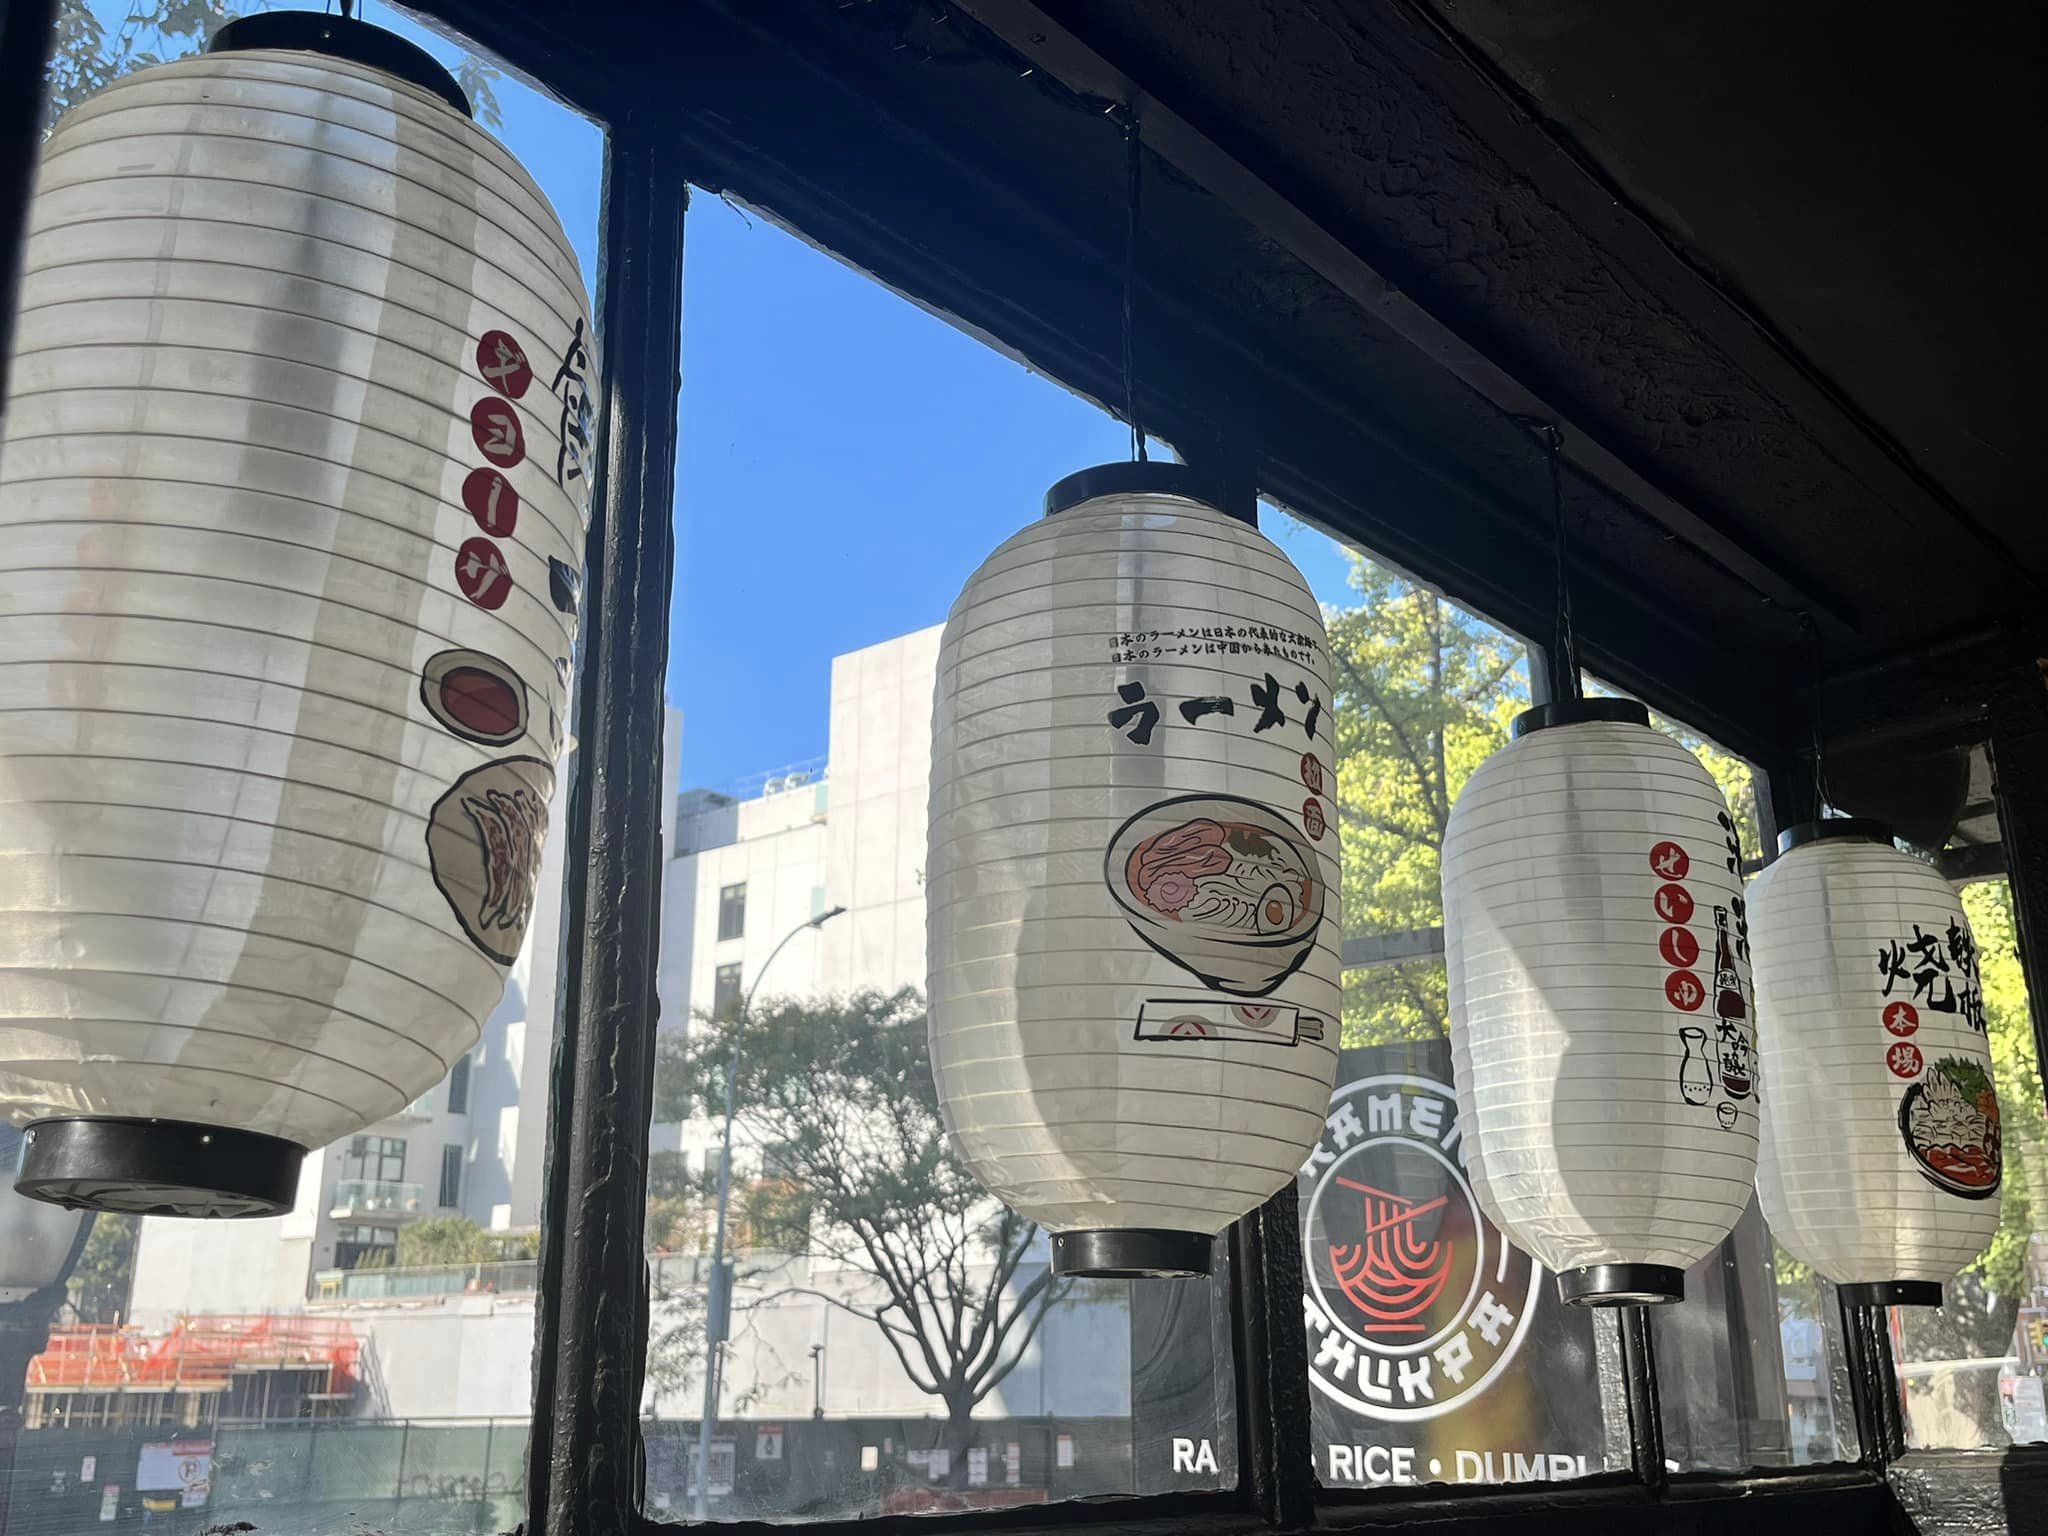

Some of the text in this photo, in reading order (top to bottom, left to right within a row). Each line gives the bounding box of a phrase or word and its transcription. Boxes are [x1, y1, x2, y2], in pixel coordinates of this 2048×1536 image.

[1108, 672, 1320, 746] ラーメン
[1328, 1444, 1416, 1484] RICE
